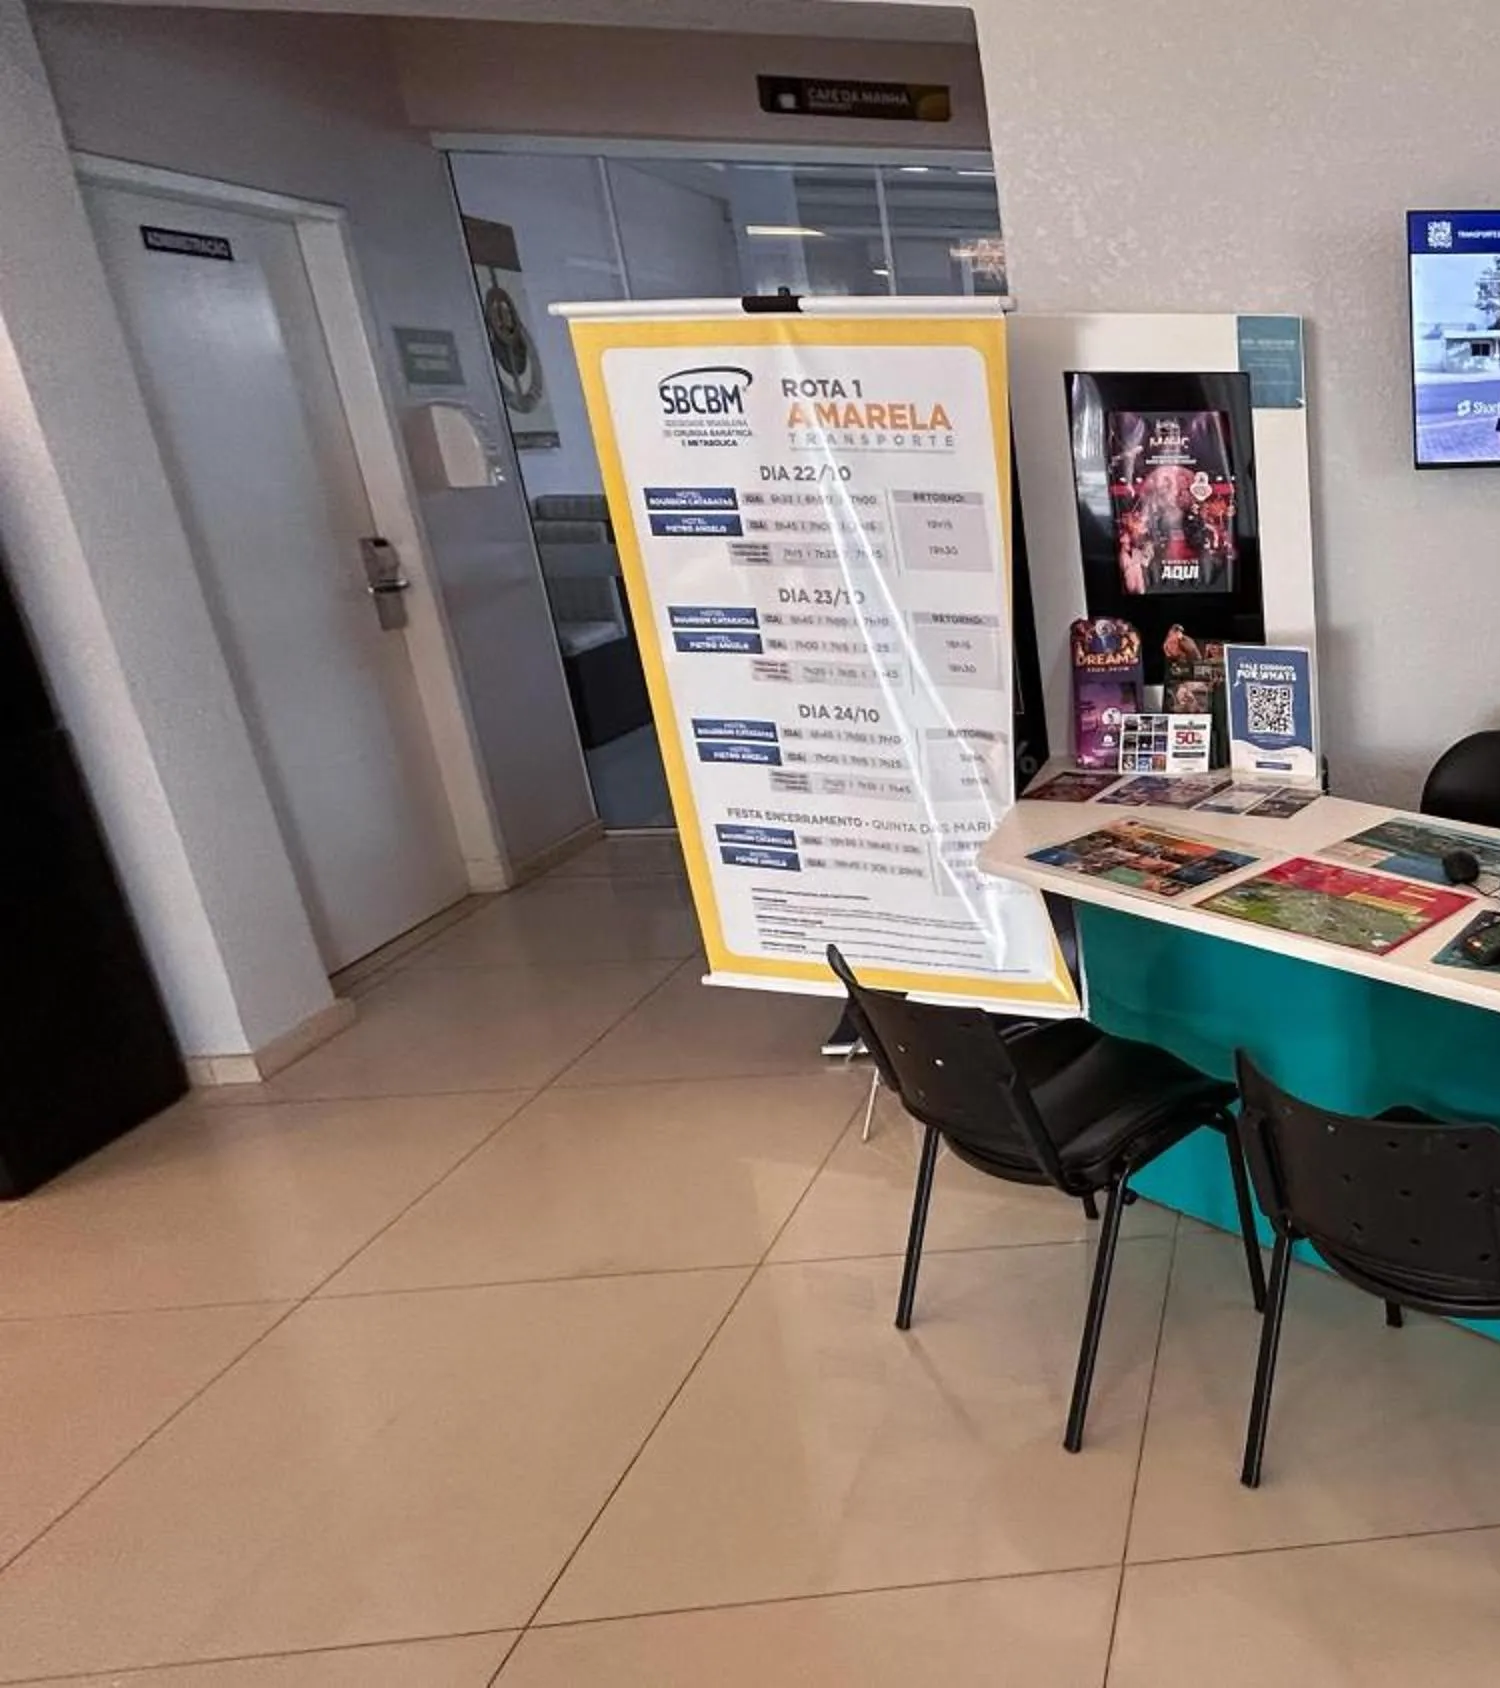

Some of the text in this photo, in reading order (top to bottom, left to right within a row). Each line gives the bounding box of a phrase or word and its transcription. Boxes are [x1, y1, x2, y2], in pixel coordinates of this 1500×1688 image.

[781, 379, 863, 399] ROTA 1
[659, 384, 744, 415] SBCBM
[787, 402, 953, 431] AMARELA
[788, 432, 956, 448] TRANSPORTE
[759, 465, 791, 482] DIA
[1160, 565, 1200, 581] AQUI
[778, 588, 866, 607] DIA 23/10
[1259, 670, 1297, 682] WHATS
[798, 703, 881, 724] DIA 24/10
[726, 807, 762, 821] FESTA
[764, 811, 863, 828] ENCERRAMENTO
[871, 819, 918, 834] QUINTA
